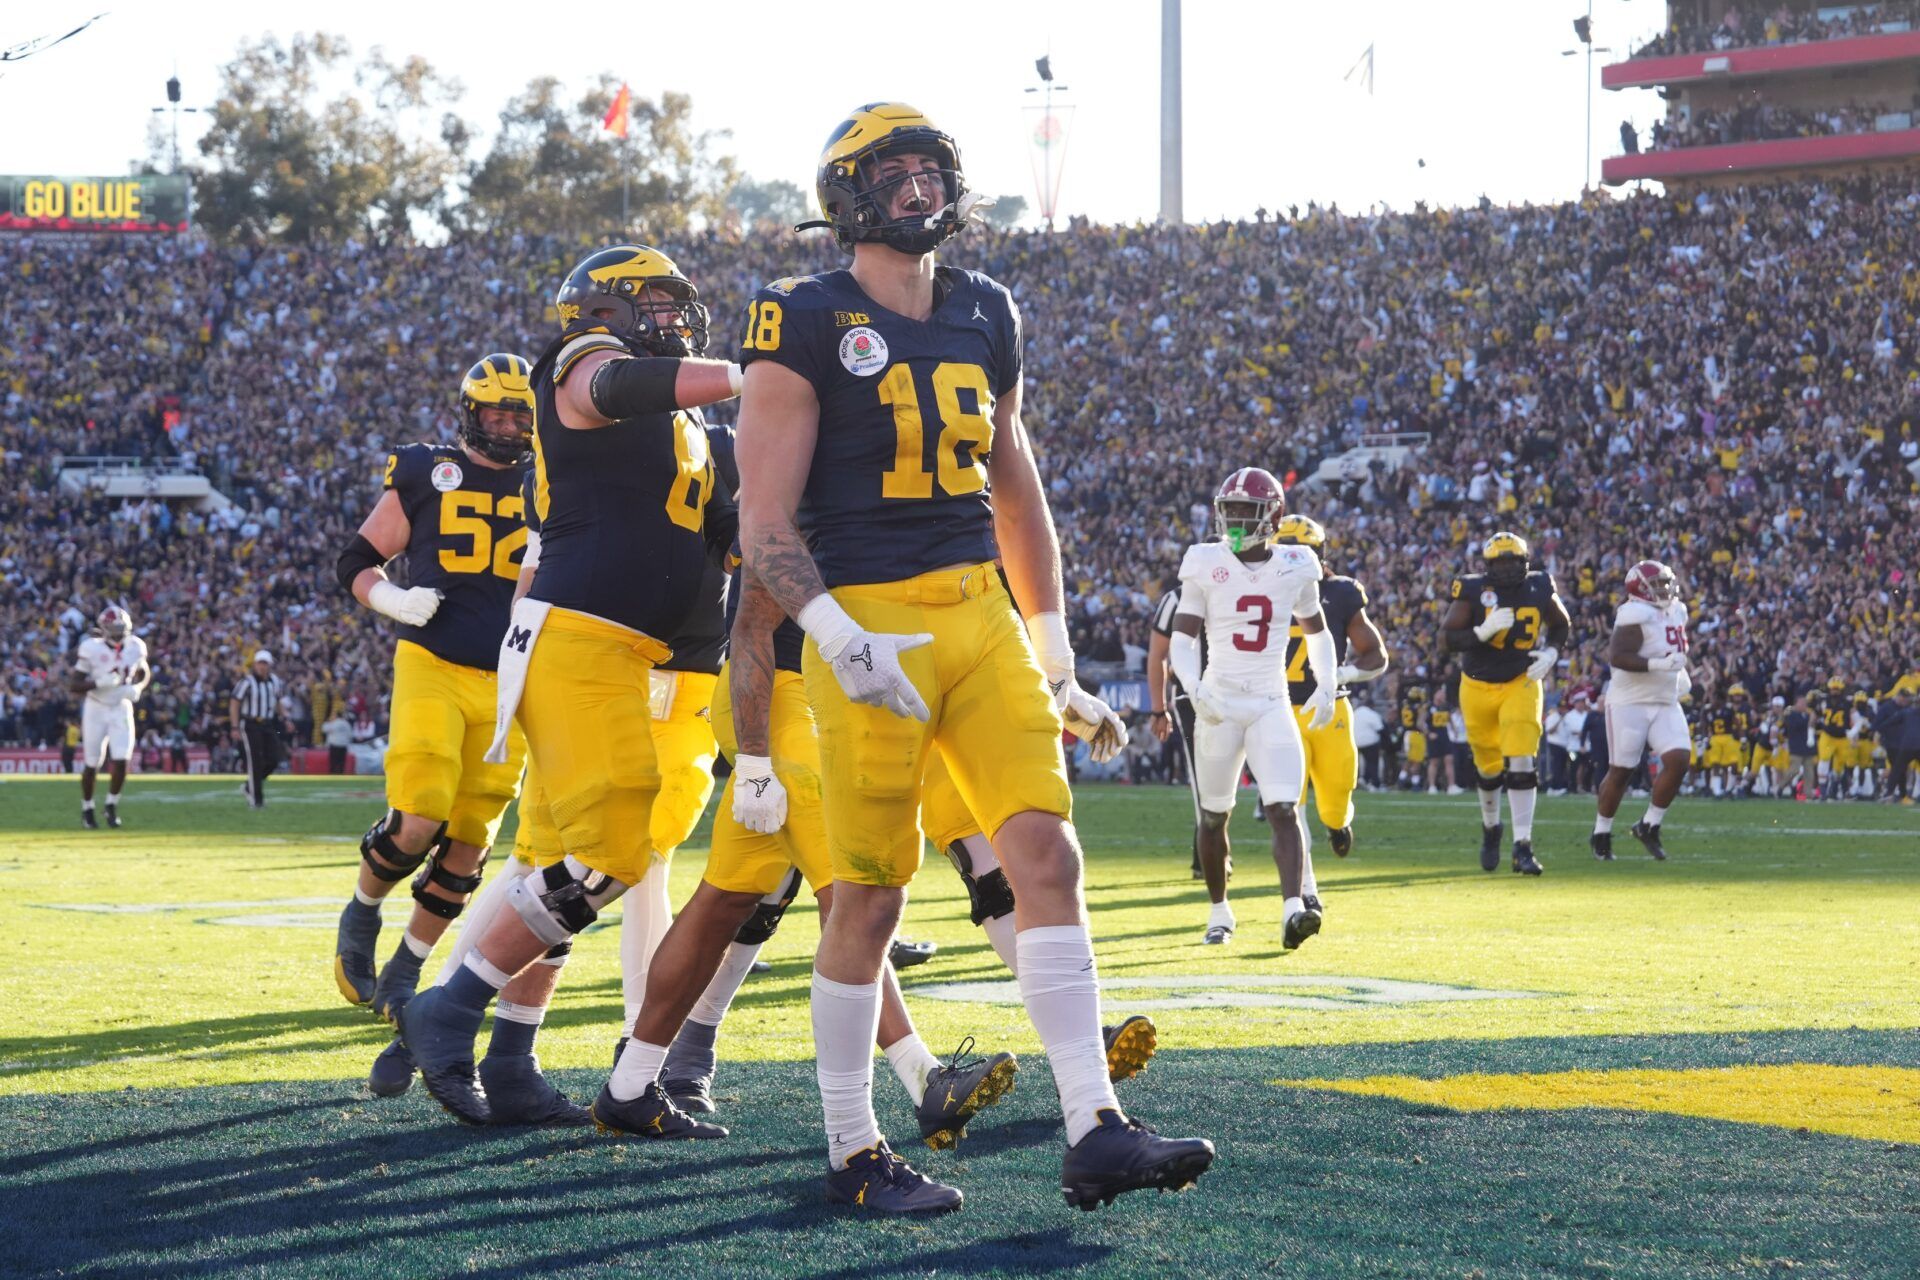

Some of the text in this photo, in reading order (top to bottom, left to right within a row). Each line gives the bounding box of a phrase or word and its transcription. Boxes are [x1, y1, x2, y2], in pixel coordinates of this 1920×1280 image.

[25, 181, 141, 219] GO BLUE
[742, 300, 783, 351] 18
[841, 330, 885, 359] ROSE BOWL GAME
[860, 361, 884, 370] Prudential
[877, 361, 994, 498] 18
[438, 490, 528, 582] 52
[507, 624, 532, 653] M
[1233, 595, 1272, 652] 3
[1823, 707, 1845, 728] 74
